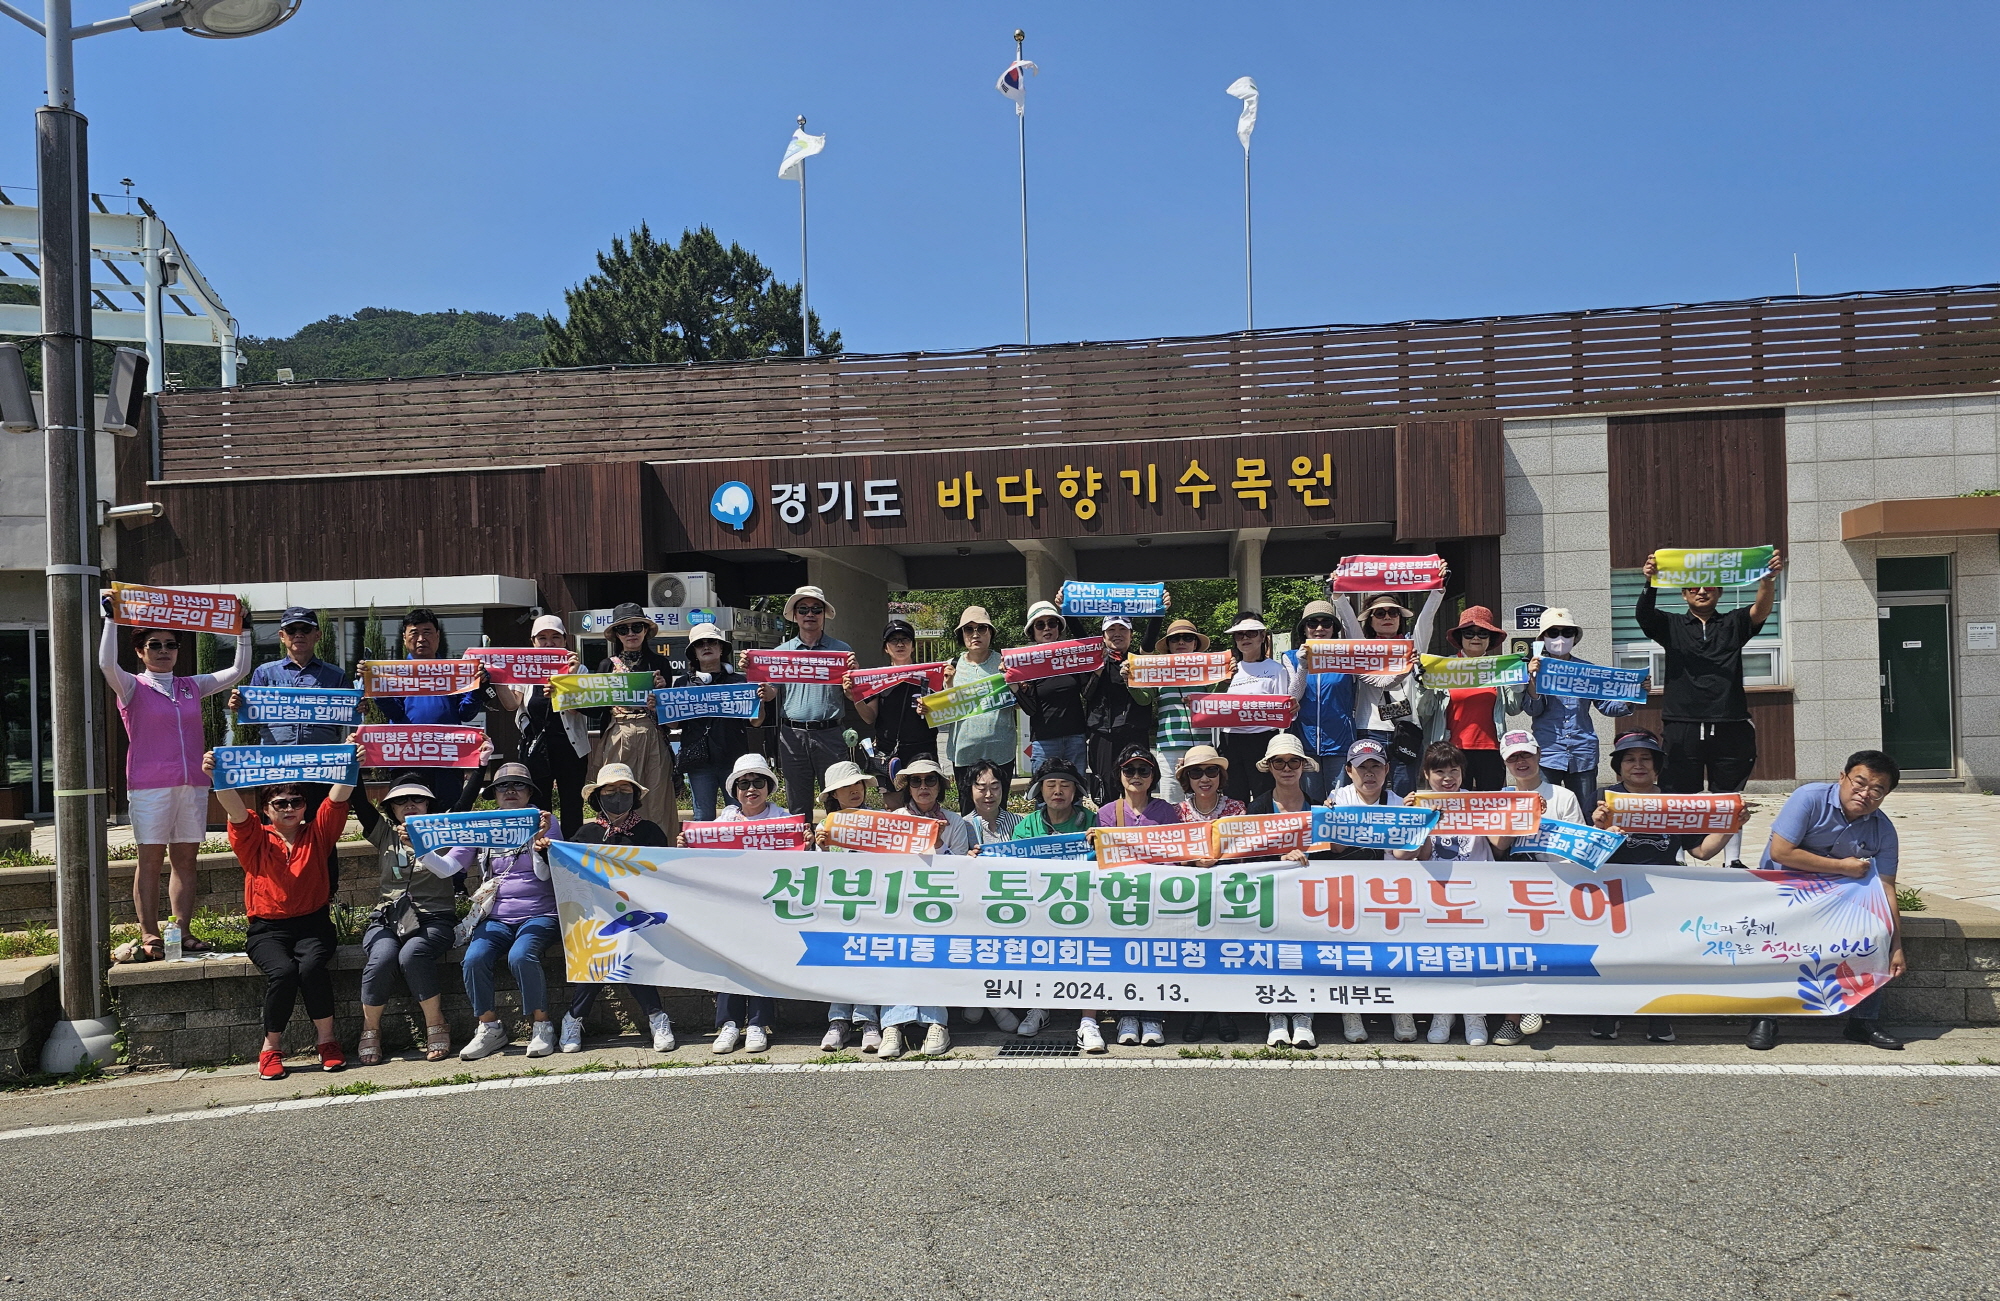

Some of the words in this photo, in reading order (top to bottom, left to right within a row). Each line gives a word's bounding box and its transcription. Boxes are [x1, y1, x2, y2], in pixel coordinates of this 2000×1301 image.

[771, 479, 901, 524] 경기도
[938, 453, 1331, 520] 바다향기수목원
[1336, 562, 1387, 577] 이민청은
[1389, 560, 1440, 570] 상호문화도시
[1684, 551, 1742, 569] 이민청!
[1384, 570, 1431, 585] 안산으로
[1657, 569, 1717, 585] 안산시가
[1067, 584, 1104, 598] 안산의
[1106, 588, 1135, 598] 새로운
[1137, 588, 1160, 598] 도전!
[120, 589, 169, 606] 이민청!
[172, 594, 214, 610] 안산의
[217, 599, 236, 612] 길!
[1070, 599, 1122, 613] 이민청과
[1124, 599, 1157, 613] 함께!
[120, 603, 207, 627] 대한민국의
[211, 612, 236, 629] 길!
[1004, 650, 1052, 669] 이민청은
[1054, 643, 1102, 657] 상호문화도시
[1312, 644, 1350, 656] 이민청!
[1353, 644, 1389, 656] 안산의
[1391, 644, 1408, 656] 길!
[516, 654, 568, 664] 상호문화도시
[753, 656, 789, 664] 이민청은
[791, 655, 845, 667] 상호문화도시
[1051, 655, 1094, 671] 안산으로
[1134, 655, 1170, 667] 이민청!
[1173, 654, 1207, 666] 안산의
[1210, 654, 1225, 665] 길!
[1312, 655, 1384, 671] 대한민국의
[1388, 657, 1408, 671] 길!
[1446, 657, 1497, 670] 이민청!
[371, 664, 413, 677] 이민청!
[417, 664, 454, 676] 안산의
[458, 664, 475, 676] 길!
[768, 666, 830, 680] 안산으로
[1134, 667, 1203, 683] 대한민국의
[1207, 666, 1226, 681] 길!
[1423, 671, 1475, 686] 안산시가
[1477, 668, 1523, 684] 합니다!
[1547, 662, 1577, 676] 안산의
[1579, 666, 1612, 680] 새로운
[1613, 670, 1639, 682] 도전!
[371, 676, 451, 693] 대한민국의
[577, 675, 628, 689] 이민청!
[1541, 674, 1600, 695] 이민청과
[1602, 680, 1640, 698] 함께!
[244, 689, 290, 705] 안산의
[292, 695, 328, 705] 새로운
[330, 696, 357, 706] 도전!
[558, 690, 608, 705] 안산시가
[660, 689, 698, 706] 안산의
[701, 691, 731, 701] 새로운
[732, 689, 756, 700] 도전!
[948, 680, 993, 704] 이민청!
[247, 704, 312, 720] 이민청과
[314, 705, 353, 722] 함께!
[665, 703, 719, 719] 이민청과
[721, 700, 753, 716] 함께!
[930, 700, 977, 723] 안산시가
[1192, 700, 1240, 715] 이민청은
[1242, 700, 1291, 710] 상호문화도시
[1238, 710, 1284, 722] 안산으로
[362, 731, 409, 744] 이민청은
[411, 731, 476, 744] 상호문화도시
[382, 744, 459, 761] 안산으로
[1352, 742, 1382, 754] BROOKLYN
[221, 749, 275, 769] 안산의
[277, 753, 318, 767] 새로운
[321, 752, 352, 765] 도전!
[302, 765, 347, 780] 함께!
[1469, 798, 1511, 811] 안산의
[1515, 798, 1533, 811] 길!
[1614, 798, 1662, 812] 이민청!
[1667, 798, 1711, 812] 안산의
[1715, 800, 1735, 813] 길!
[412, 817, 463, 834] 안산의
[465, 818, 503, 828] 새로운
[505, 816, 534, 827] 도전!
[832, 812, 873, 828] 이민청!
[876, 817, 914, 835] 안산의
[917, 823, 931, 837] 길!
[1218, 820, 1260, 835] 이민청!
[1263, 817, 1303, 833] 안산의
[1324, 812, 1358, 824] 안산의
[1360, 812, 1396, 825] 새로운
[1398, 813, 1426, 826] 도전!
[1434, 812, 1506, 830] 한민국의
[1511, 812, 1533, 830] 길!
[1612, 812, 1704, 829] 대한민국의
[1708, 814, 1733, 829] 길!
[421, 829, 489, 850] 이민청과
[489, 827, 530, 845] 함께!
[685, 825, 745, 844] 이민청은
[747, 823, 804, 836] 상호문화도시
[830, 825, 908, 851] 대한민국의
[1101, 831, 1142, 846] 이민청!
[1146, 829, 1186, 844] 안산의
[1188, 827, 1206, 841] 길!
[1317, 824, 1386, 844] 이민청과
[1388, 826, 1430, 846] 함께!
[1588, 831, 1618, 849] 도전!
[741, 835, 794, 850] 안산으로
[1029, 844, 1062, 856] 새로운
[1065, 841, 1091, 853] 도전!
[1220, 833, 1299, 854] 대한민국의
[1103, 844, 1184, 865] 대한민국의
[1187, 841, 1209, 858] 길!
[763, 865, 960, 923] 선부1동
[981, 870, 1275, 929] 통장협의회
[1298, 874, 1485, 931] 대부도
[1507, 878, 1627, 934] 투어
[1679, 915, 1738, 942] 시민과
[842, 935, 935, 963] 선부1동
[948, 938, 1112, 966] 통장협의회는
[1124, 940, 1206, 968] 이민청
[1219, 942, 1303, 970] 유치를
[1316, 944, 1373, 971] 적극
[1387, 944, 1548, 972] 기원합니다.
[1702, 940, 1754, 966] 자유로운
[1761, 940, 1822, 963] 혁신도시
[1829, 937, 1879, 958] 안산
[983, 979, 1024, 999] 일시
[1053, 981, 1113, 1001] 2024.
[1124, 983, 1145, 1001] 6.
[1157, 984, 1190, 1003] 13.
[1255, 984, 1298, 1004] 장소
[1329, 985, 1395, 1005] 대부도
